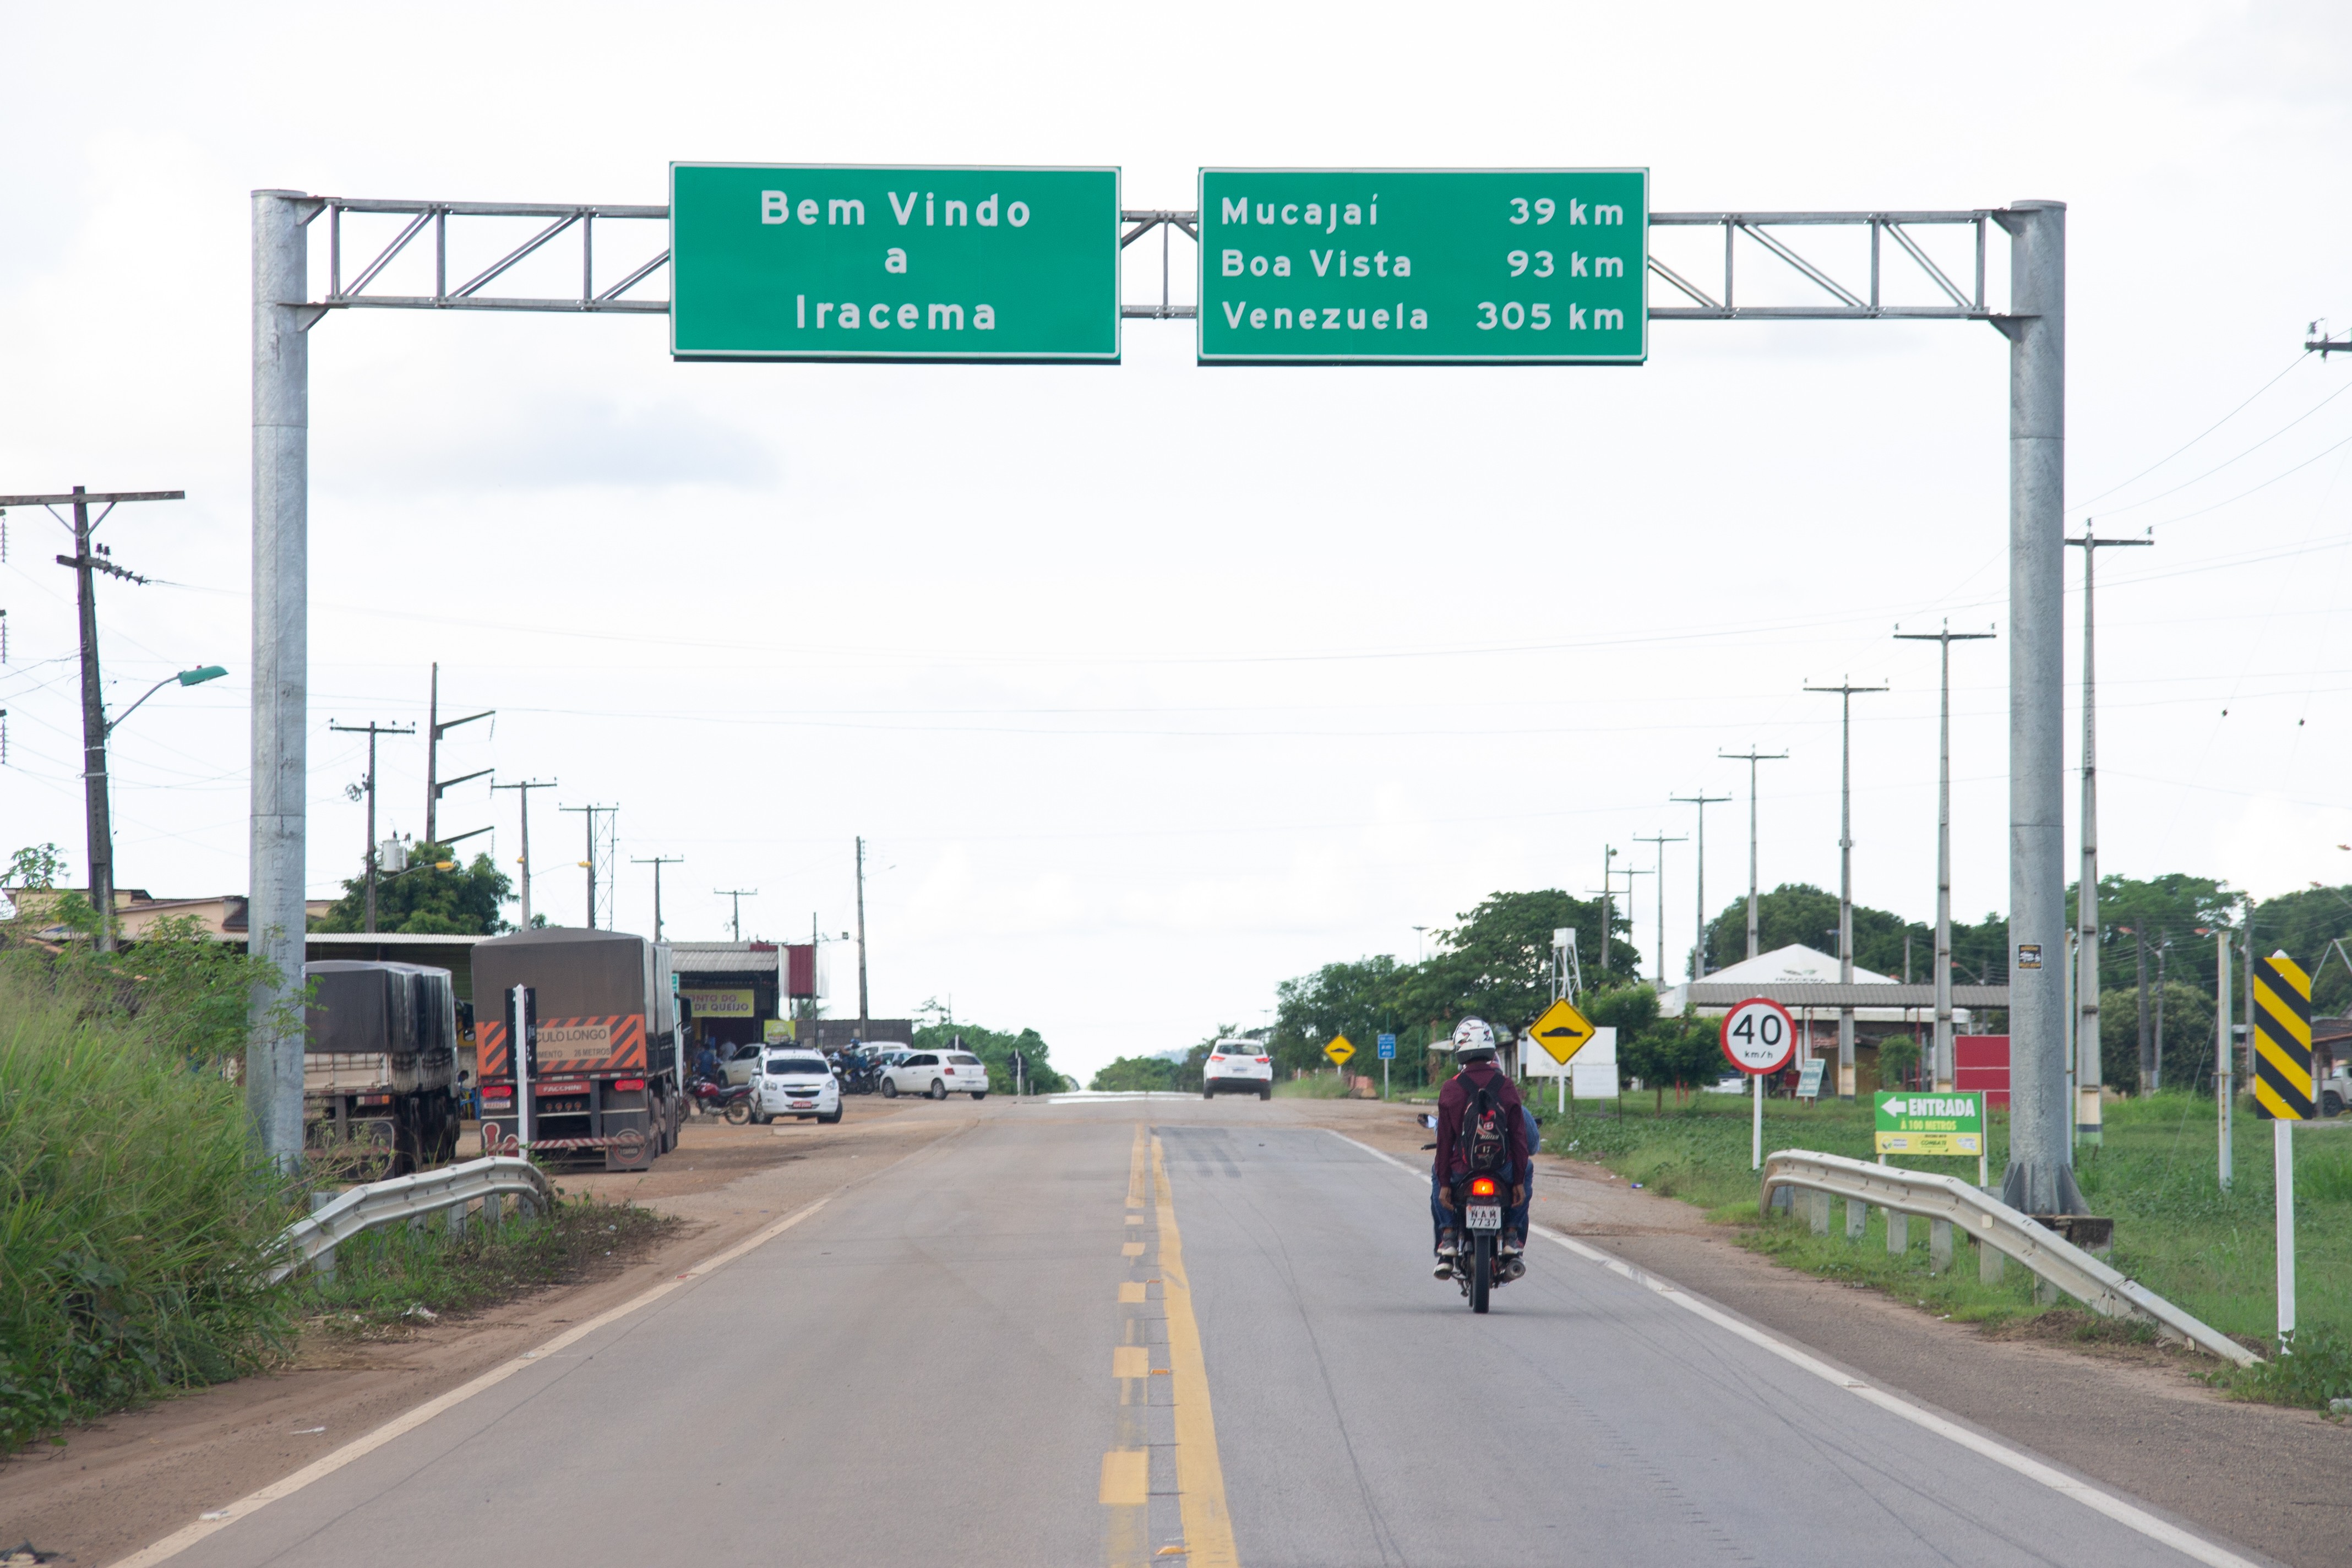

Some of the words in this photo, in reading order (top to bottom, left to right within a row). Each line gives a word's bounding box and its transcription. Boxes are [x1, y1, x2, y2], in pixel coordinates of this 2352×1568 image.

[761, 190, 865, 225] Bem
[888, 192, 1030, 227] Vindo
[1222, 193, 1376, 234] Mucajaí
[1509, 198, 1555, 225] 39
[1570, 198, 1624, 225] km
[885, 248, 907, 274] a
[1222, 249, 1291, 277] Boa
[1310, 249, 1411, 277] Vista
[1507, 250, 1554, 277] 93
[1571, 251, 1623, 277] km
[797, 295, 995, 330] Iracema
[1222, 301, 1428, 330] Venezuela
[1477, 302, 1551, 330] 305
[1570, 303, 1624, 330] km
[695, 1003, 707, 1011] DE
[711, 1003, 749, 1012] QUEIJO
[536, 1031, 564, 1043] CULO
[567, 1028, 607, 1041] LONGO
[1733, 1014, 1782, 1046] 40
[582, 1048, 611, 1056] METROS
[1909, 1098, 1975, 1117] ENTRADA
[1909, 1120, 1924, 1130] 100
[1925, 1120, 1957, 1131] METROS
[1470, 1218, 1497, 1227] 7737
